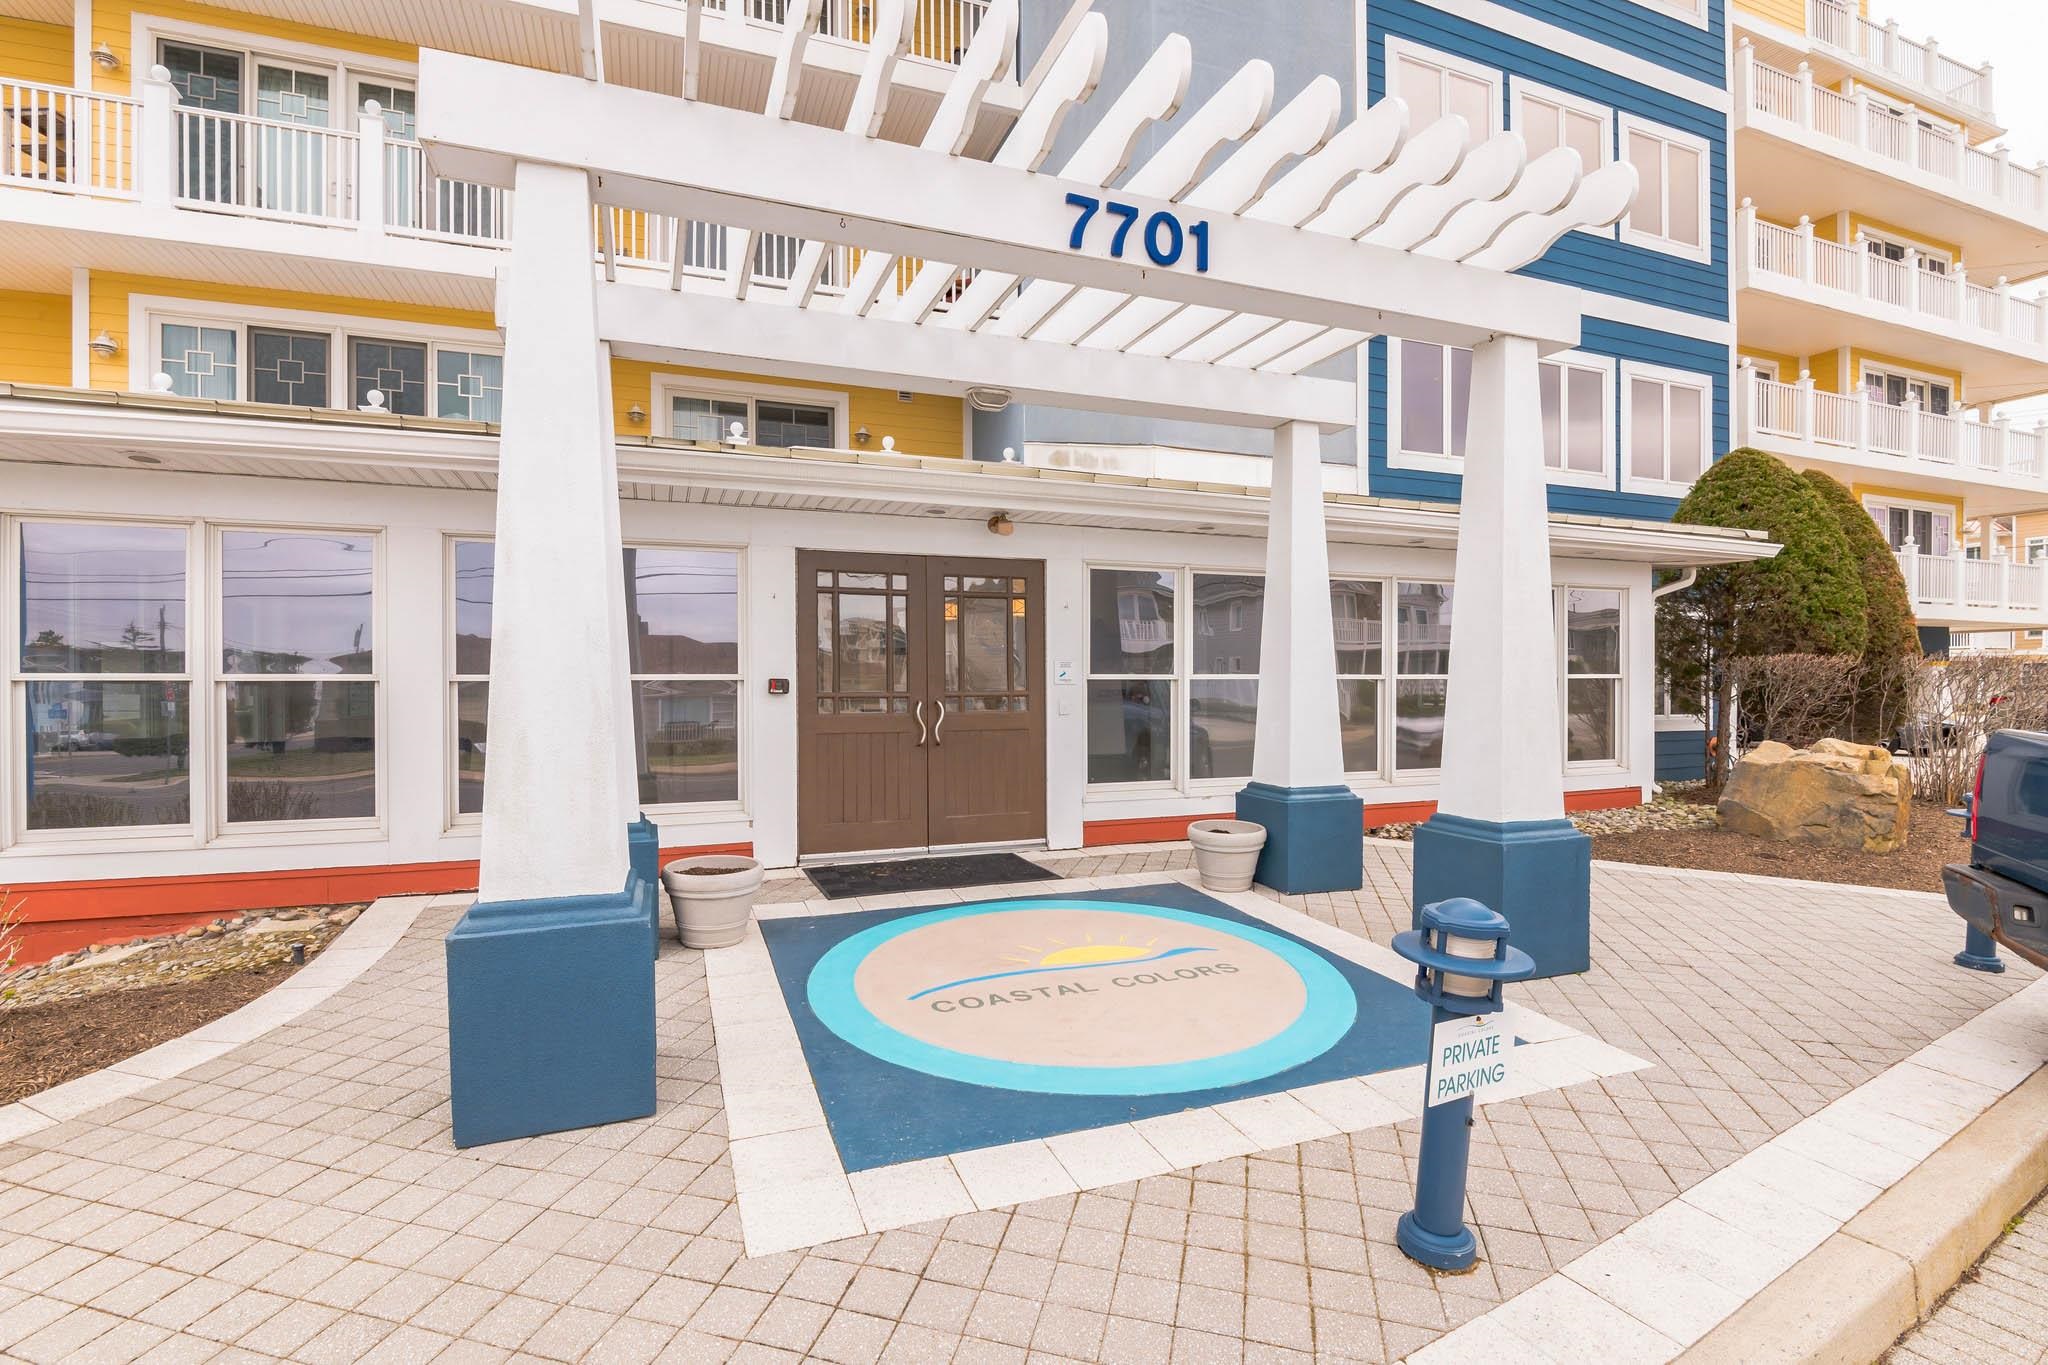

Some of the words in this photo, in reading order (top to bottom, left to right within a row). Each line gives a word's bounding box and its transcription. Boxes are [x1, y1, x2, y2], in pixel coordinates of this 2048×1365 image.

[1065, 192, 1209, 273] 7701
[930, 982, 1099, 1013] COASTAL
[1111, 963, 1240, 988] COLORS
[1442, 1034, 1500, 1067] PRIVATE
[1437, 1063, 1505, 1099] PARKING
